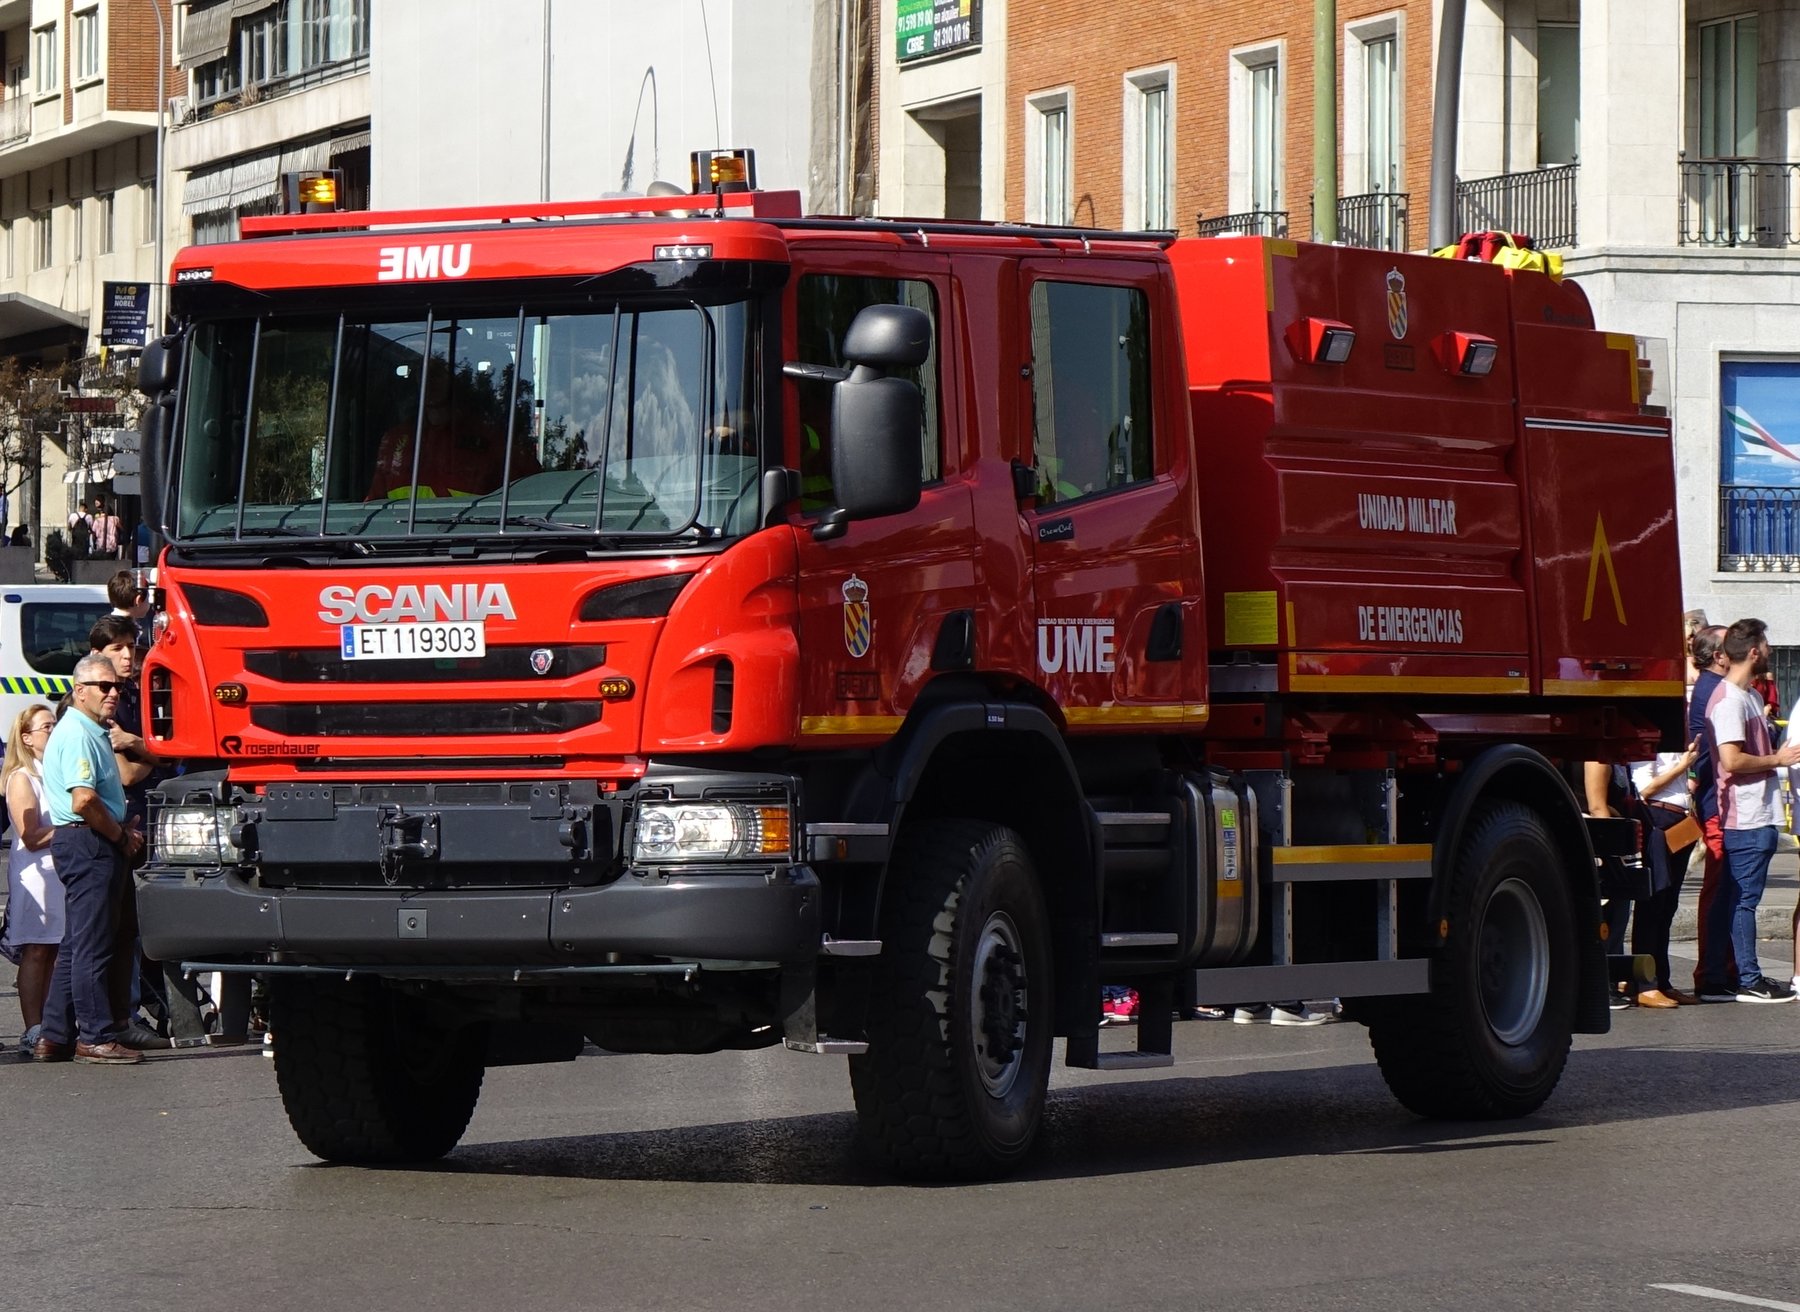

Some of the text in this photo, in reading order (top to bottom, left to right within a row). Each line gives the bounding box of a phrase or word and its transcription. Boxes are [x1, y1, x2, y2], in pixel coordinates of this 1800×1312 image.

[933, 28, 941, 48] 91
[941, 25, 953, 46] 310
[953, 23, 961, 43] 10
[1358, 493, 1457, 535] UNIDAD MILITAR
[318, 583, 517, 624] SCANIA
[360, 627, 477, 655] ET119303
[1358, 605, 1463, 644] DE EMERGENCIAS
[1038, 626, 1115, 674] UME
[245, 740, 320, 755] rosenbauer
